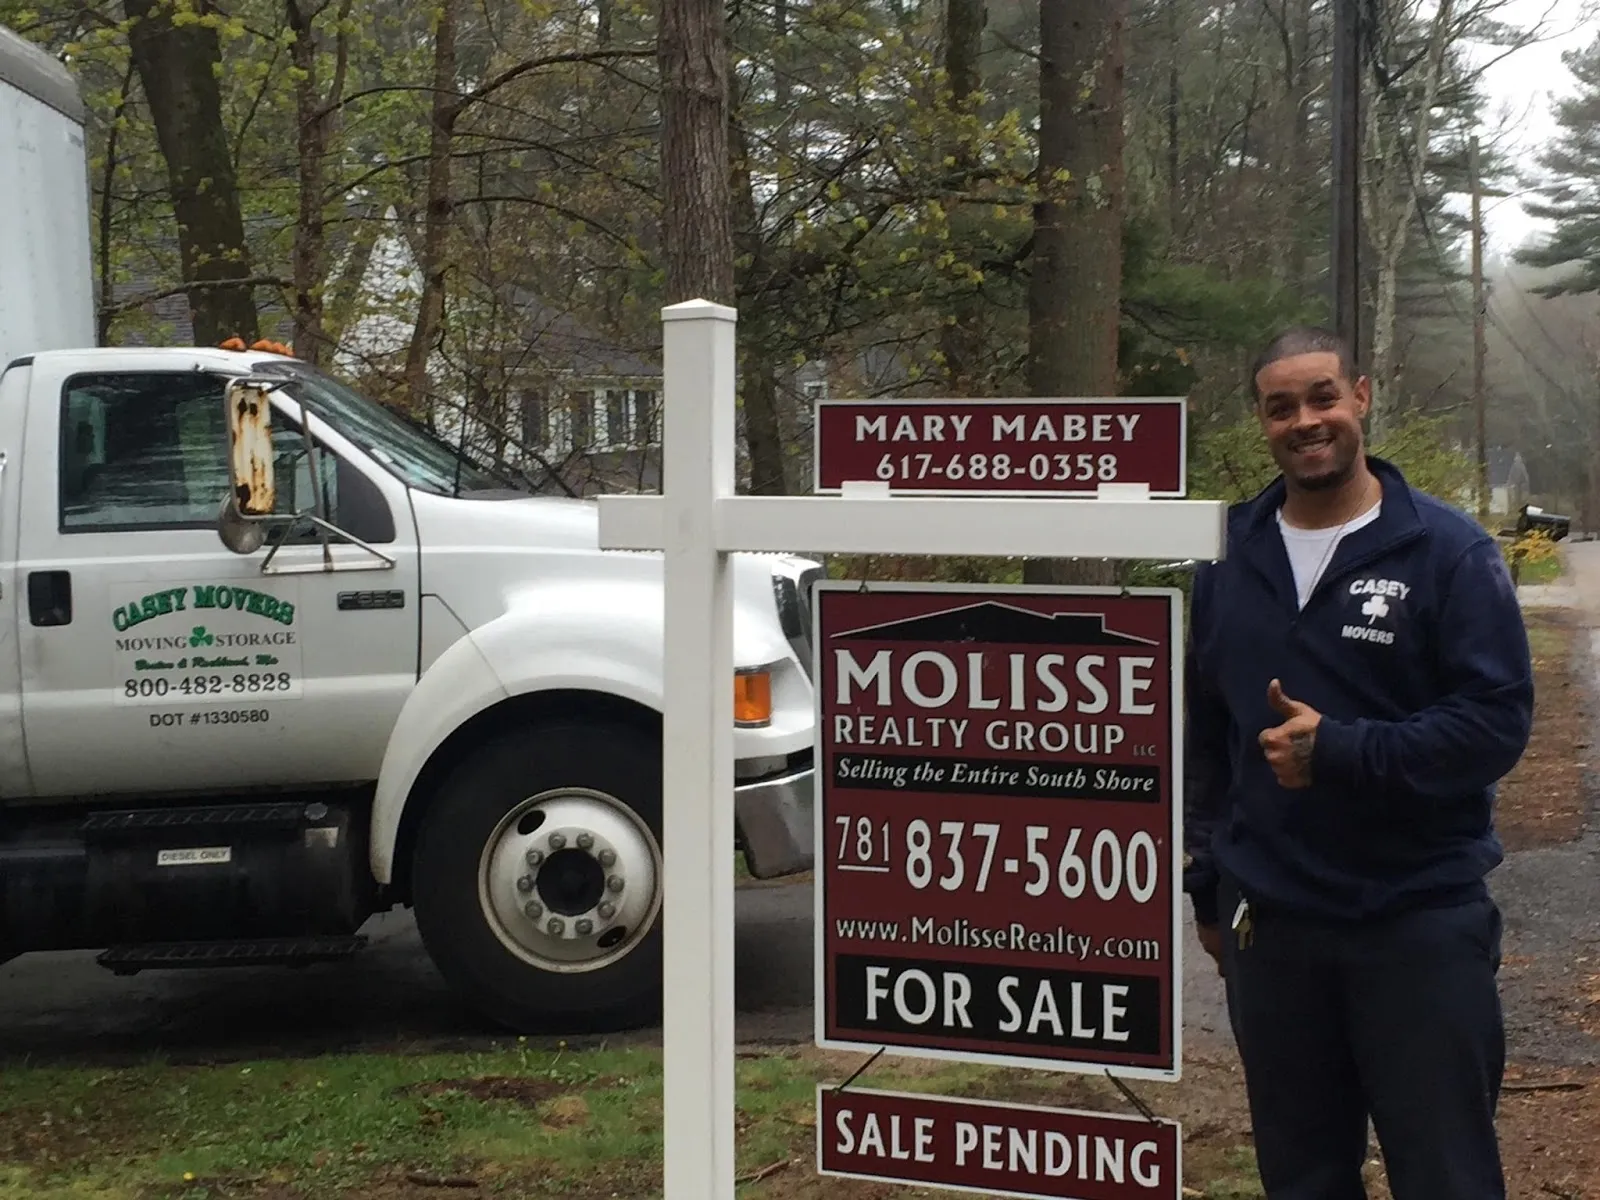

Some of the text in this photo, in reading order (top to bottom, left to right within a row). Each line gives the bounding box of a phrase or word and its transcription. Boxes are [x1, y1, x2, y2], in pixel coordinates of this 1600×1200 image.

[855, 414, 1141, 442] MARY MABEY
[876, 454, 1118, 480] 617-688-0358
[1349, 579, 1411, 600] CASEY
[112, 585, 296, 632] CASEY MOVERS
[115, 631, 296, 652] MOVING STORAGE
[1341, 625, 1395, 645] MOVERS
[124, 672, 292, 698] 800-482-8828
[834, 649, 1156, 715] MOLISSE
[149, 709, 269, 727] DOT #1330580
[834, 715, 1156, 757] REALTY GROUP LLC
[838, 758, 1154, 792] Selling the Entire South Shore
[835, 816, 1158, 904] 781 837-5600
[836, 916, 1161, 961] www.MolisseRealty.com
[866, 966, 1130, 1042] FOR SALE
[836, 1109, 1161, 1189] SALE PENDING
